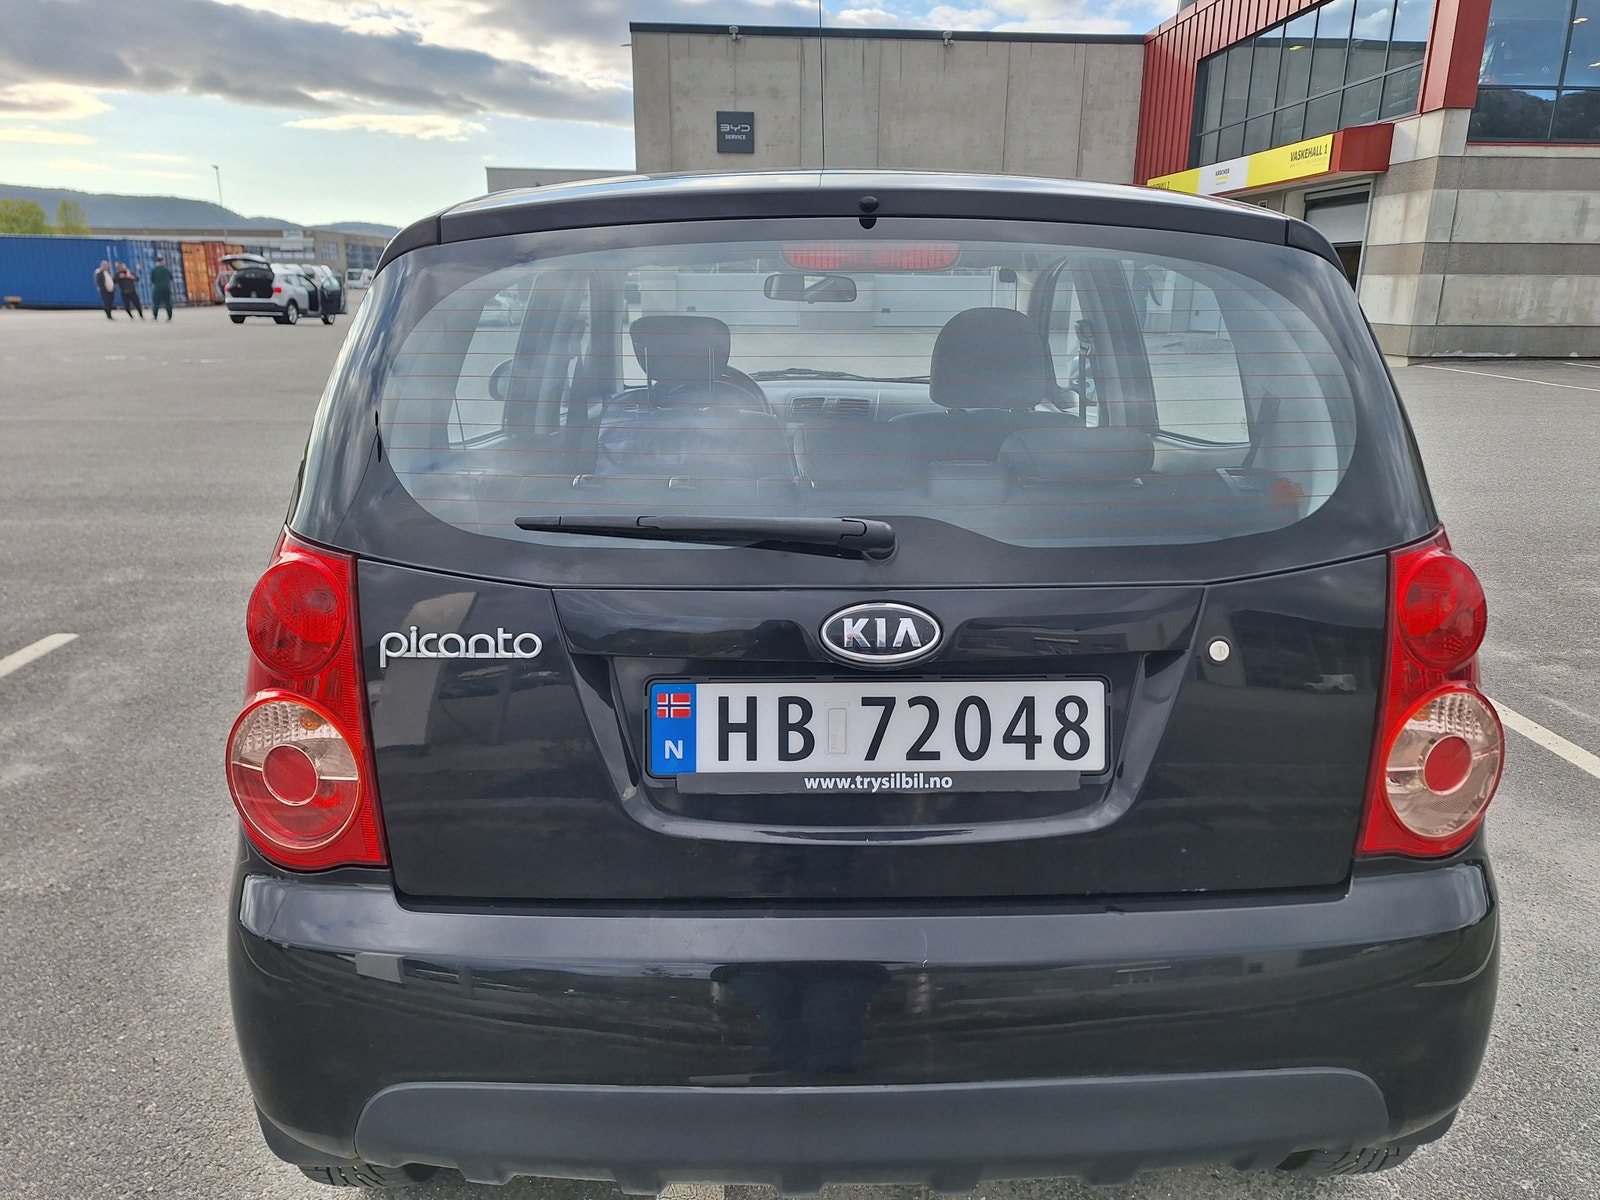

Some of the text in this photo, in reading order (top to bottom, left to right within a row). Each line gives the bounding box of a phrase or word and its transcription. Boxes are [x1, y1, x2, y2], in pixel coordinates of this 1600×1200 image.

[720, 123, 751, 132] BYD
[1290, 143, 1328, 162] VASKEHALL 1
[842, 617, 922, 648] KIA
[379, 625, 543, 668] picanto
[664, 694, 1092, 762] N HB 72048
[803, 773, 954, 793] www.trysilbil.no
